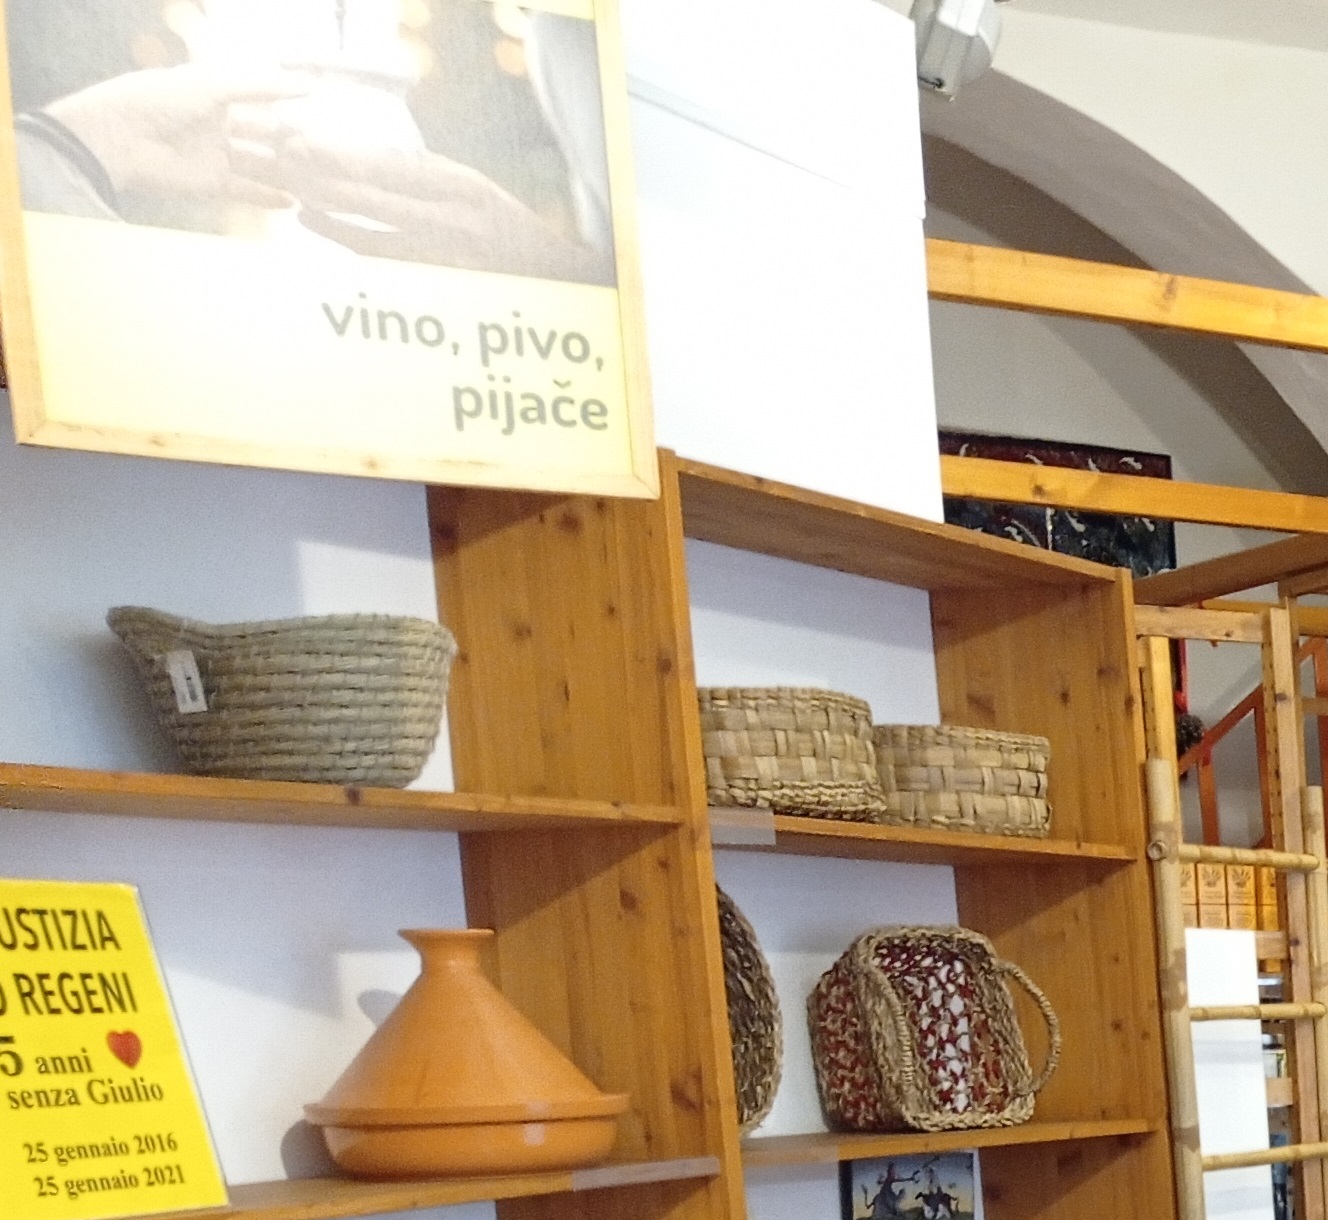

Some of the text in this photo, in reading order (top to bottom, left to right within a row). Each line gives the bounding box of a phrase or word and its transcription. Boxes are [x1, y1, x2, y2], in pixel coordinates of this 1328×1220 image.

[321, 291, 604, 372] vino, pivo,
[452, 373, 608, 436] pijače
[13, 971, 139, 1017] REGENI
[35, 1048, 93, 1075] anni
[7, 1077, 165, 1110] senza Giulio
[23, 1132, 179, 1167] 25 gennaio 2016
[34, 1163, 186, 1200] 25 gennaio 2021
